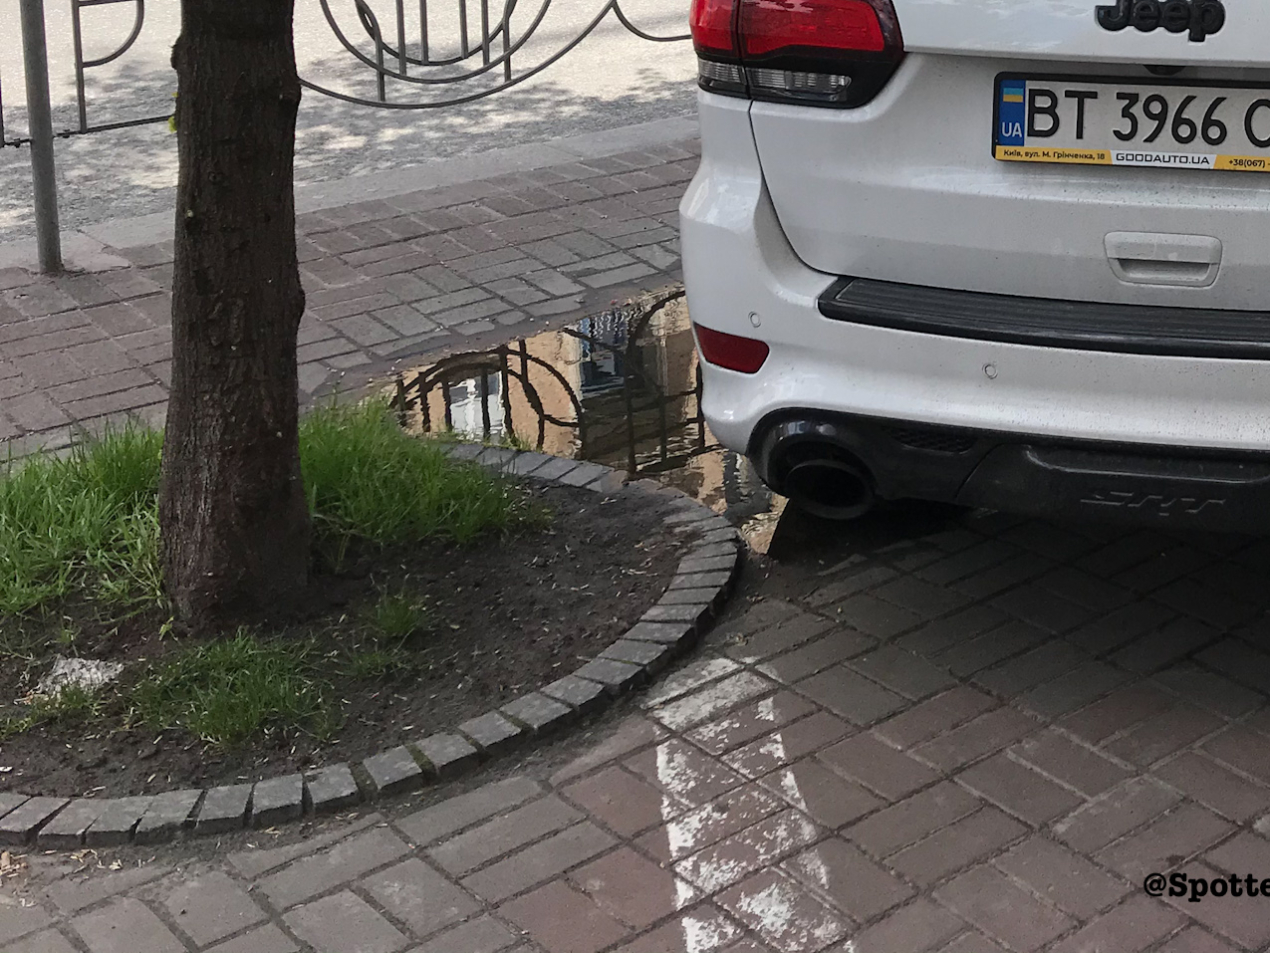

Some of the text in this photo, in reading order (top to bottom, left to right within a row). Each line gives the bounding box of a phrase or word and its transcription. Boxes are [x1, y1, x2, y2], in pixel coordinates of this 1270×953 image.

[1027, 88, 1099, 139] BT
[1112, 92, 1228, 146] 3966
[1002, 122, 1023, 138] UA
[1004, 149, 1023, 158] Київ,
[1024, 151, 1040, 159] вул.
[1053, 151, 1096, 161] Грінченка,
[1116, 152, 1210, 165] GOODAUTO.UA
